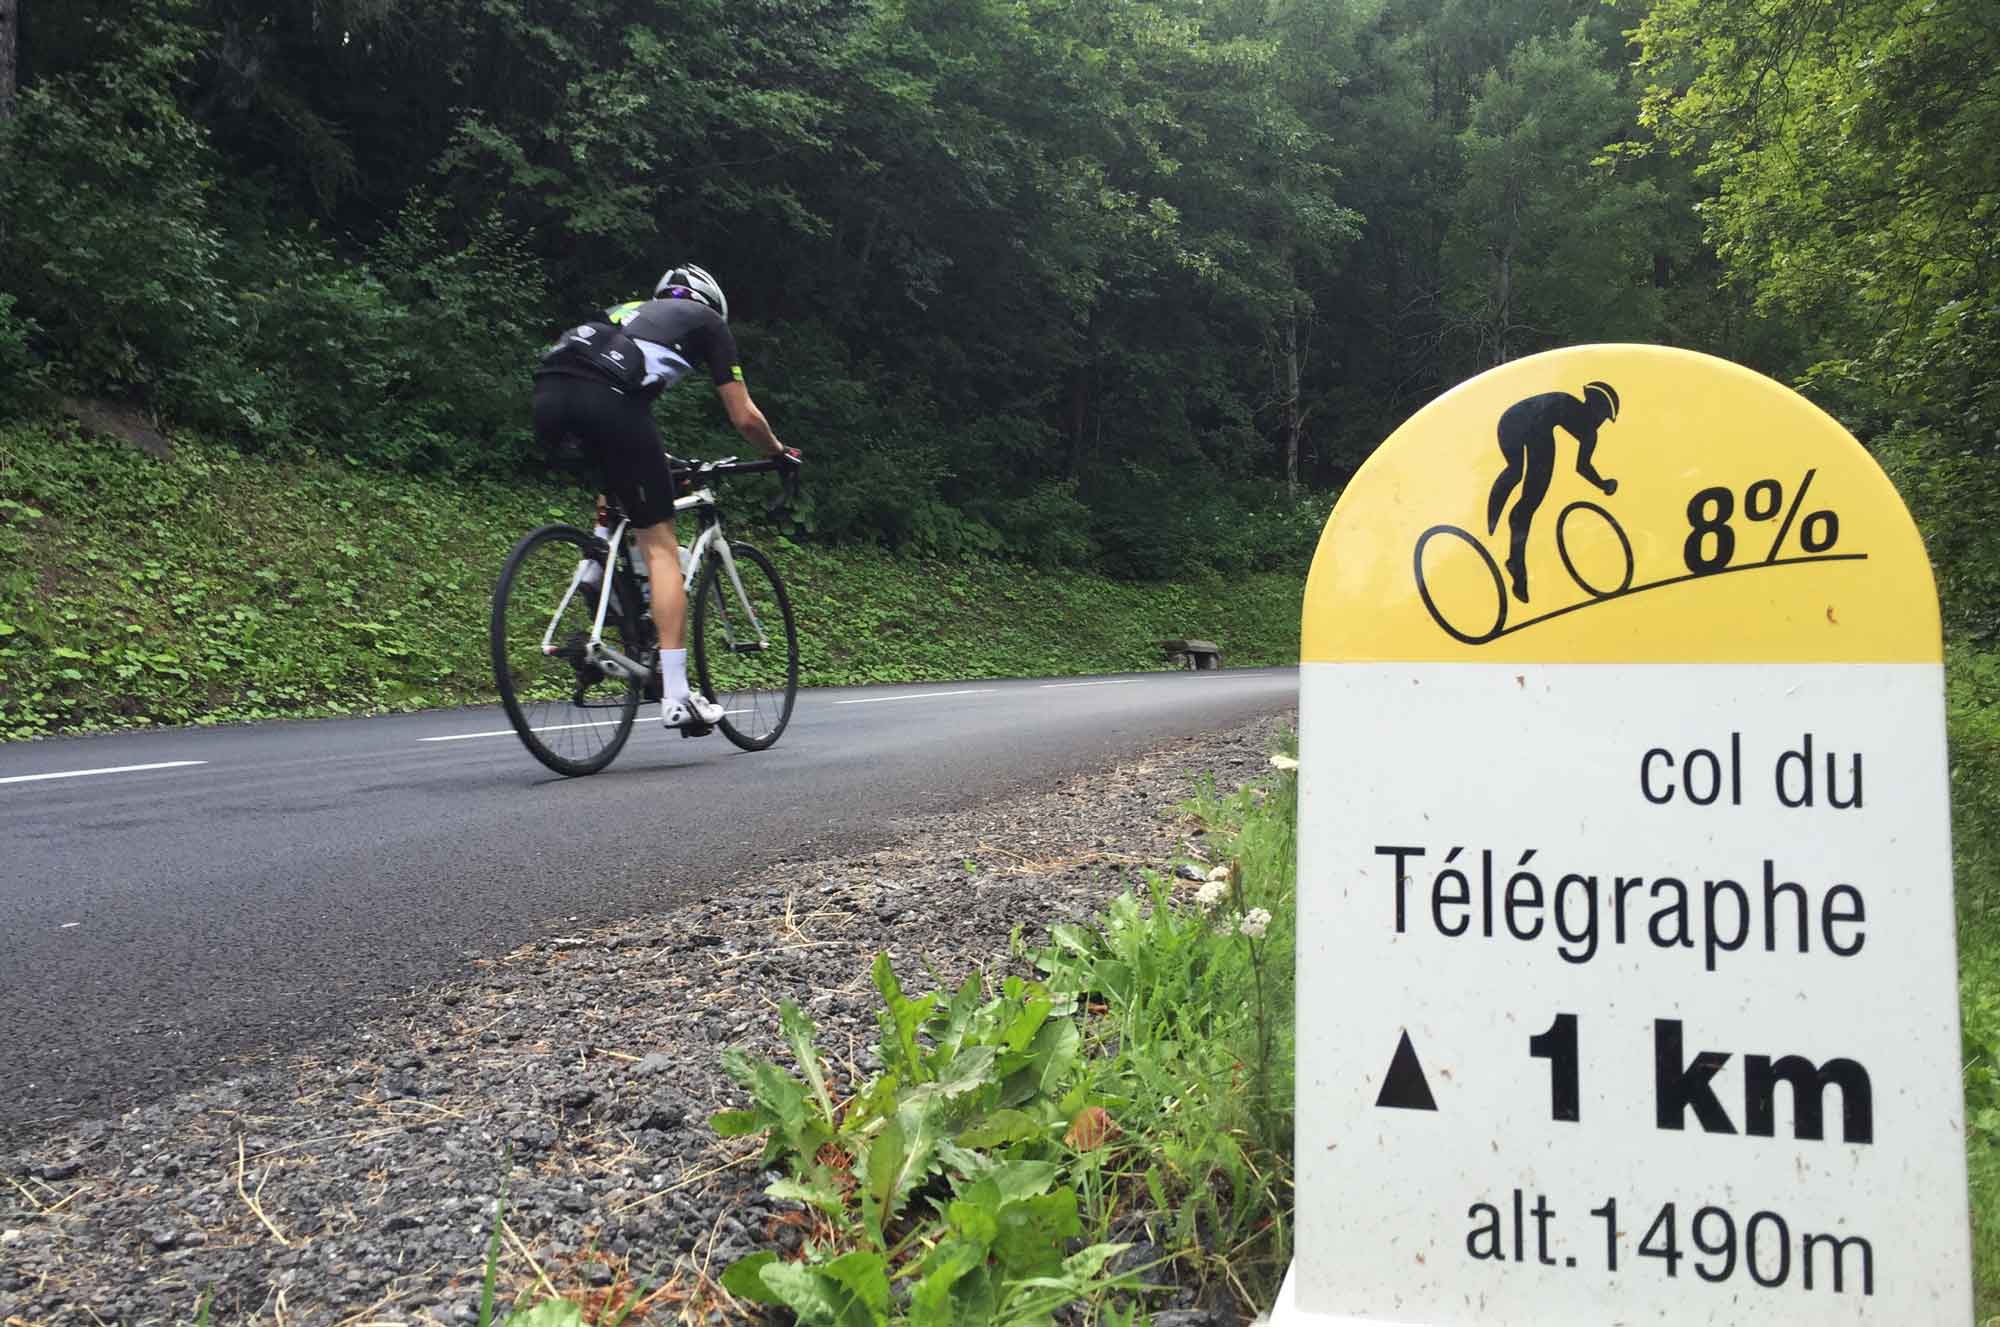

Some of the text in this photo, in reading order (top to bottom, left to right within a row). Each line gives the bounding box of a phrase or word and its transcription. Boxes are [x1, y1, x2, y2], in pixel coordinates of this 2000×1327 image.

[1683, 467, 1840, 575] 8%
[1640, 732, 1864, 810] col du
[1374, 846, 1866, 973] Télégraphe
[1529, 1013, 1874, 1146] 1 km
